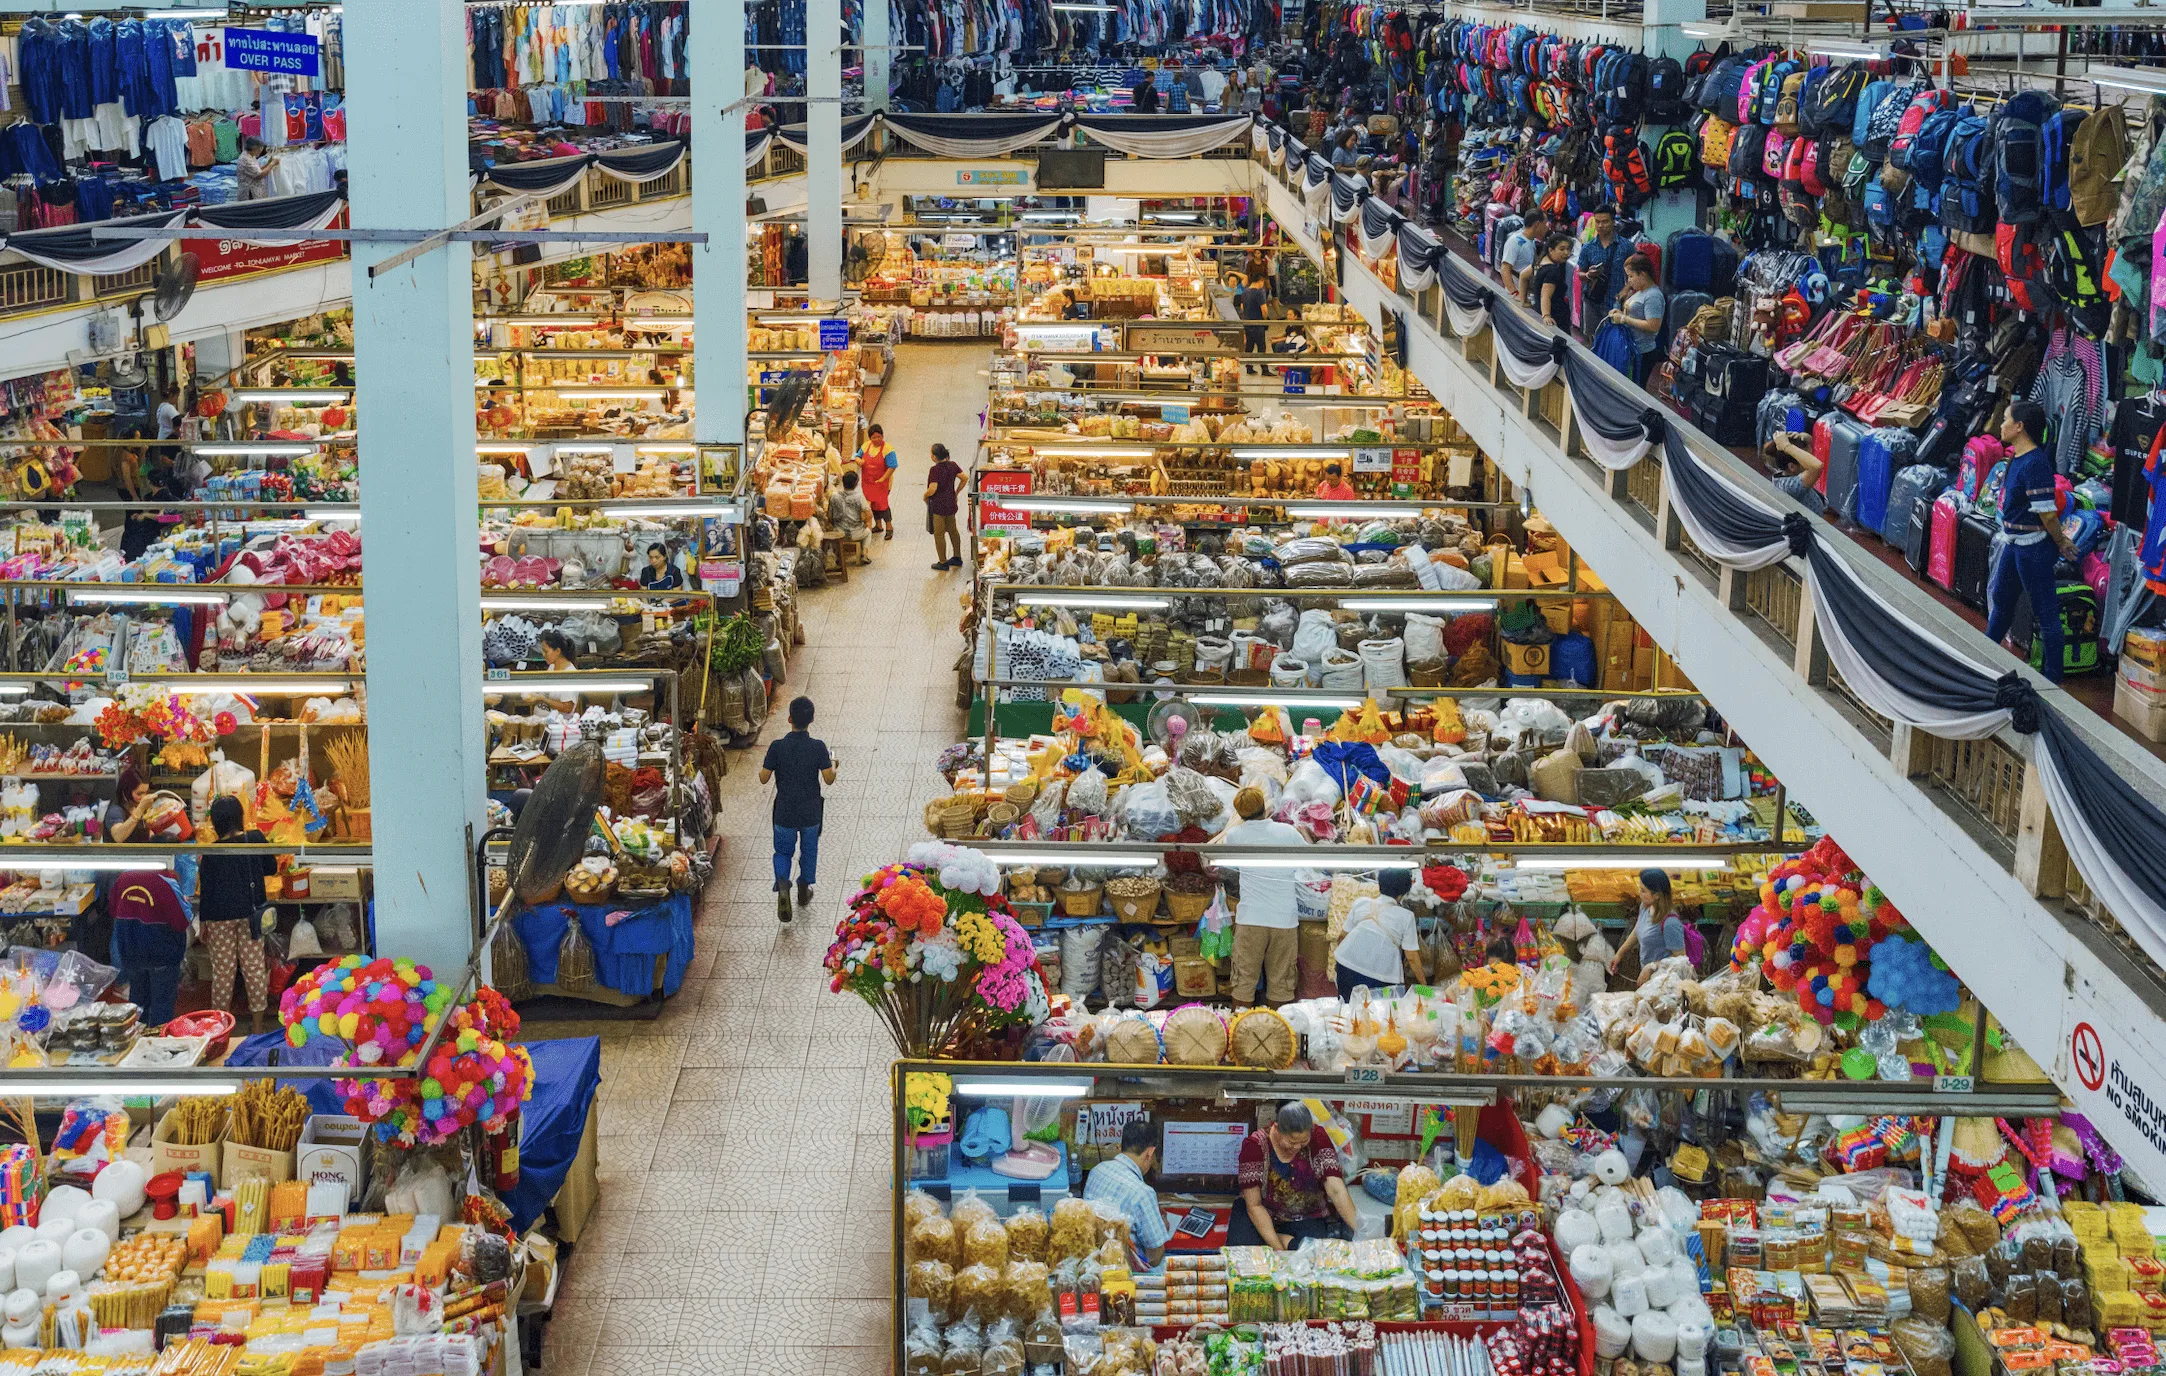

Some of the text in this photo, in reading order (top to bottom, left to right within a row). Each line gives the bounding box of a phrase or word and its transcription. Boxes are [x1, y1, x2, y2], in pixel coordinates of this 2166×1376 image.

[227, 35, 316, 55] ทางไปสะพานลอย
[239, 52, 302, 70] OVER PASS
[201, 264, 232, 275] WELCOME
[989, 511, 1024, 521] 价钱公道
[2106, 1084, 2166, 1156] NO SMOKIN
[311, 1171, 345, 1180] HONG
